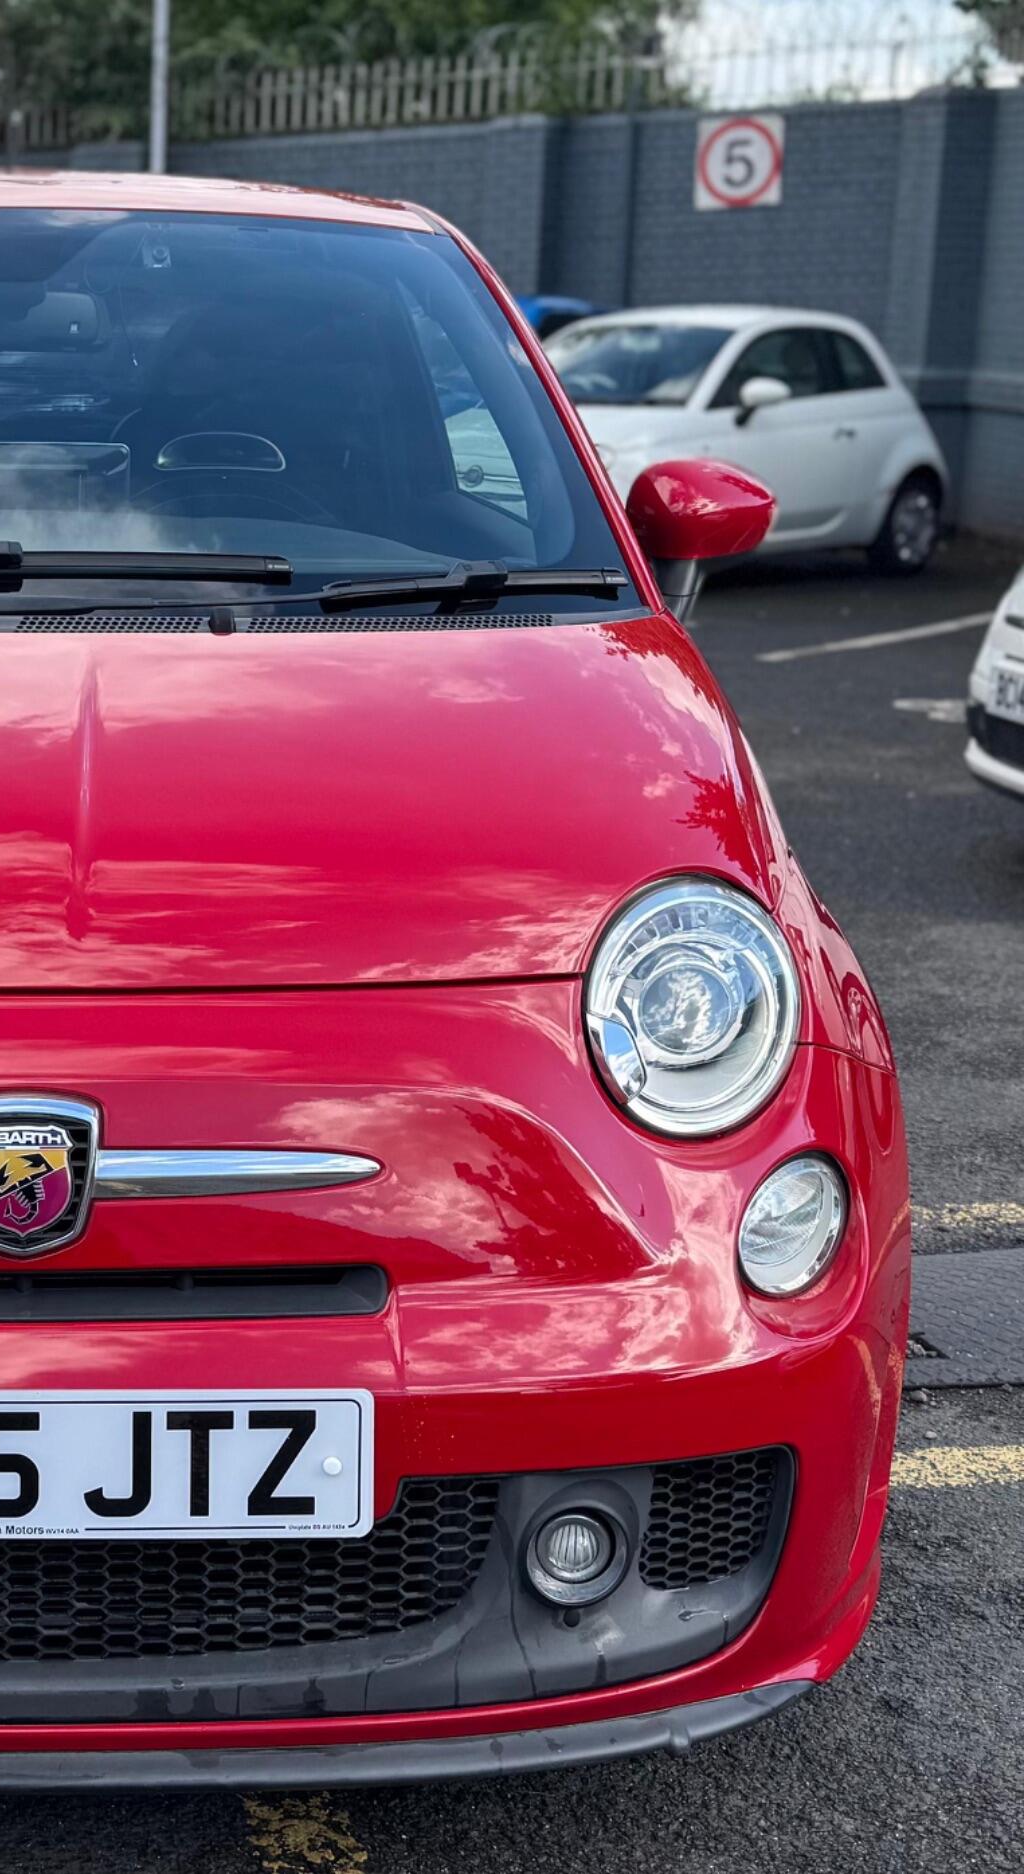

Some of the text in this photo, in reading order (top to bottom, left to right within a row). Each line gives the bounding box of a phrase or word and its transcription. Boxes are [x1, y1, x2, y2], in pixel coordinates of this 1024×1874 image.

[724, 139, 754, 189] 5
[83, 1409, 317, 1518] JTZ
[5, 1525, 44, 1535] Motors
